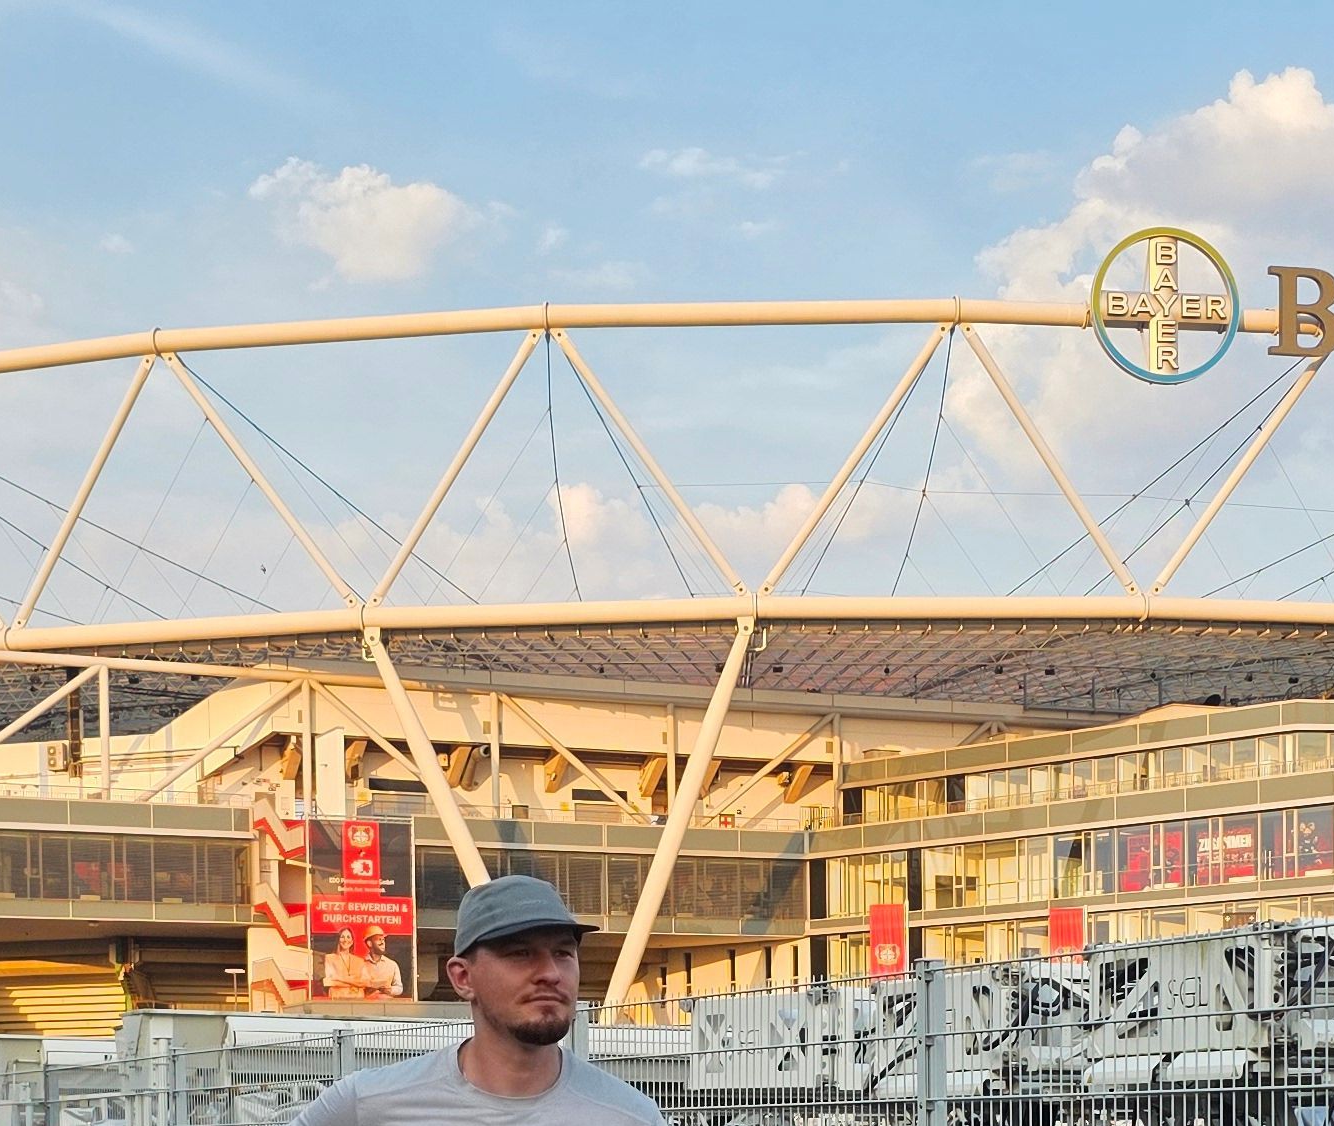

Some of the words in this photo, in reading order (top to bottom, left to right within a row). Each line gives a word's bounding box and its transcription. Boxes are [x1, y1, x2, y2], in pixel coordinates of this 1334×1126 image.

[1107, 292, 1227, 320] BAYER
[1155, 241, 1178, 371] BAYER
[316, 901, 347, 911] JETZT
[348, 902, 400, 913] BEWERBEN
[401, 904, 408, 913] &
[323, 913, 402, 925] DURCHSTARTEN!
[1166, 976, 1209, 1011] SGL
